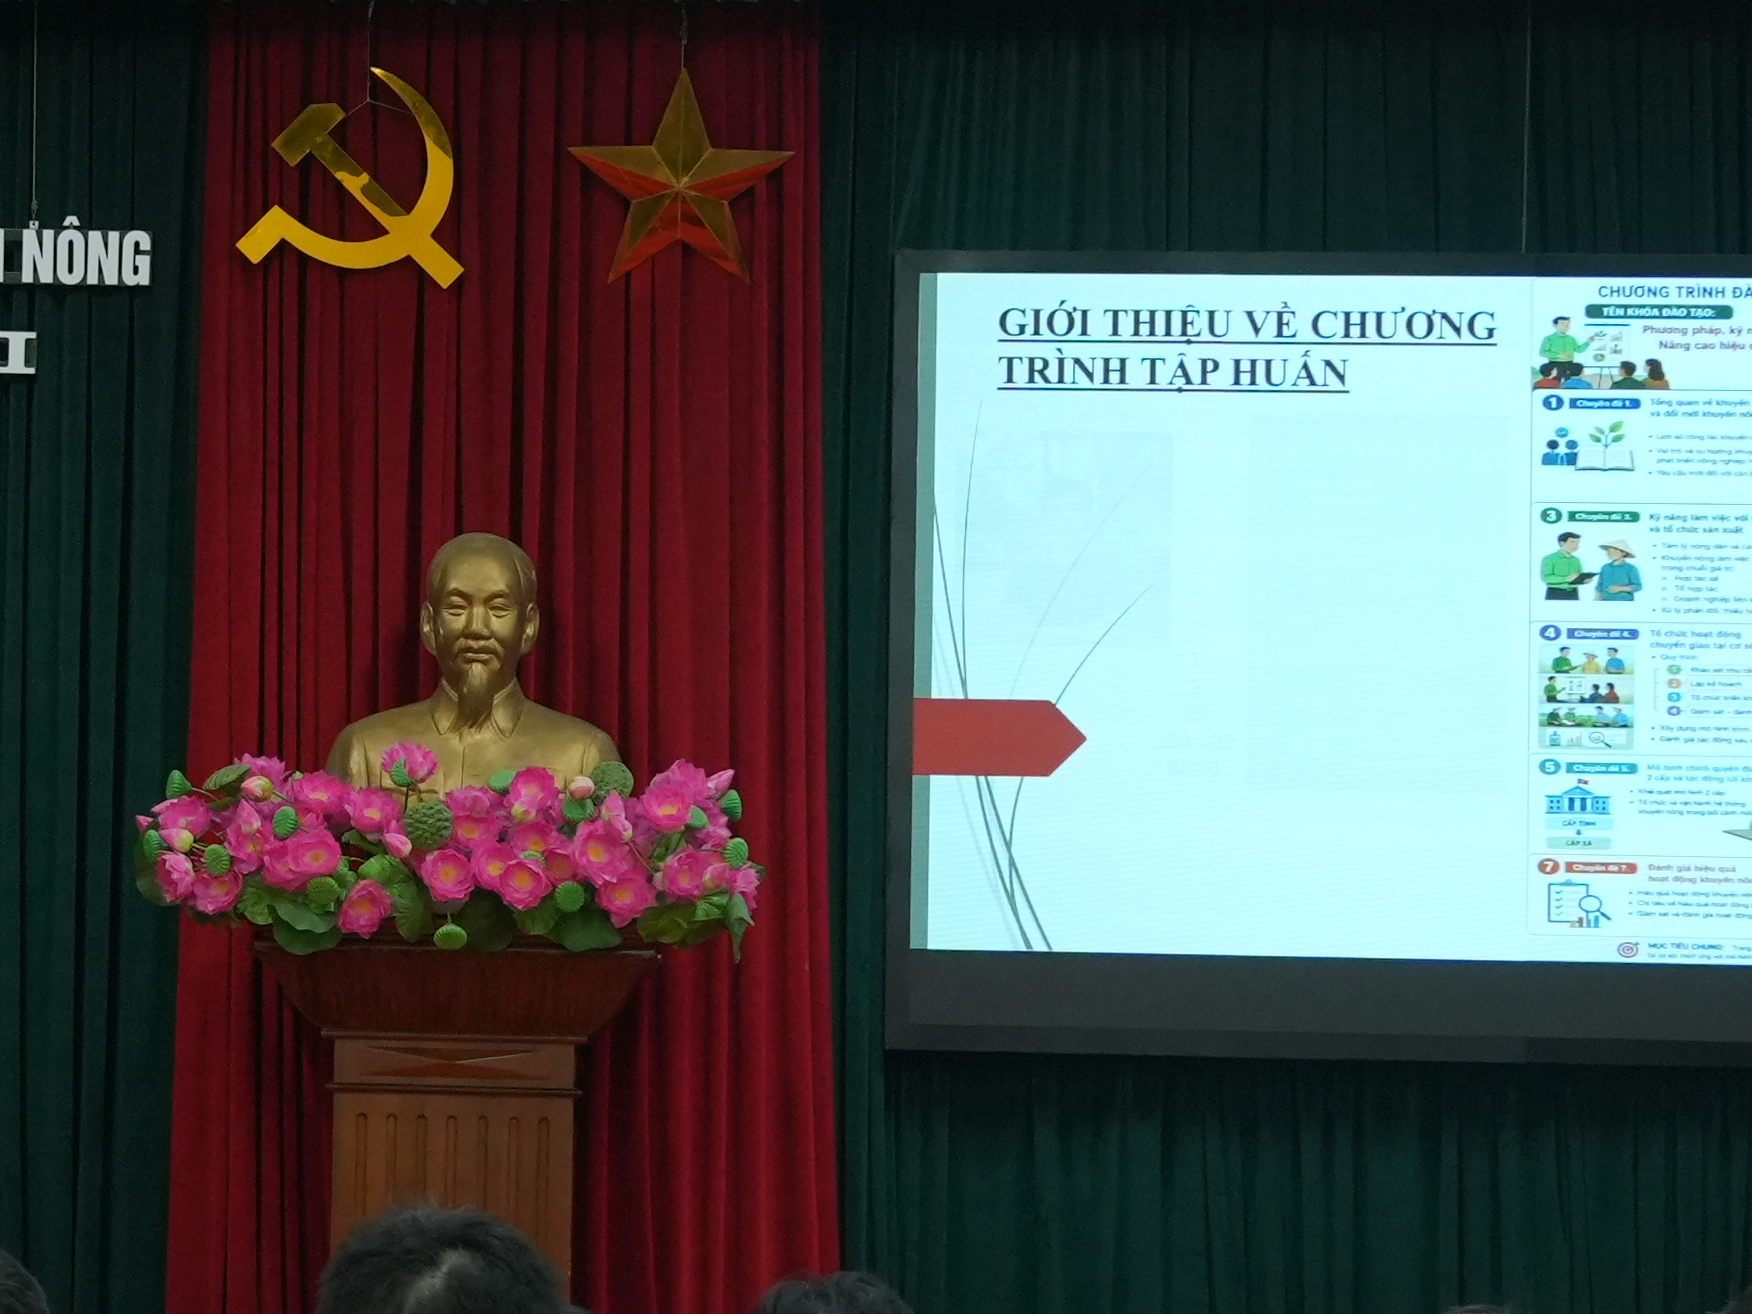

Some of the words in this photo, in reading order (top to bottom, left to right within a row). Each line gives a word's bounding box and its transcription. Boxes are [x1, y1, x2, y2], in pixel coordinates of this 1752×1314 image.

[21, 215, 151, 286] NÔNG
[1597, 285, 1670, 298] CHƯƠNG
[1674, 283, 1725, 298] TRÌNH
[998, 300, 1092, 338] GIỚI
[1103, 304, 1232, 345] THIỆU
[1242, 301, 1298, 338] VỀ
[1311, 307, 1497, 341] CHƯƠNG
[1641, 325, 1689, 337] Phương
[1693, 342, 1716, 350] cao
[1718, 341, 1746, 352] hiệu
[998, 348, 1130, 386] TRÌNH
[1141, 352, 1221, 393] TẬP
[1231, 349, 1350, 388] HUẤN
